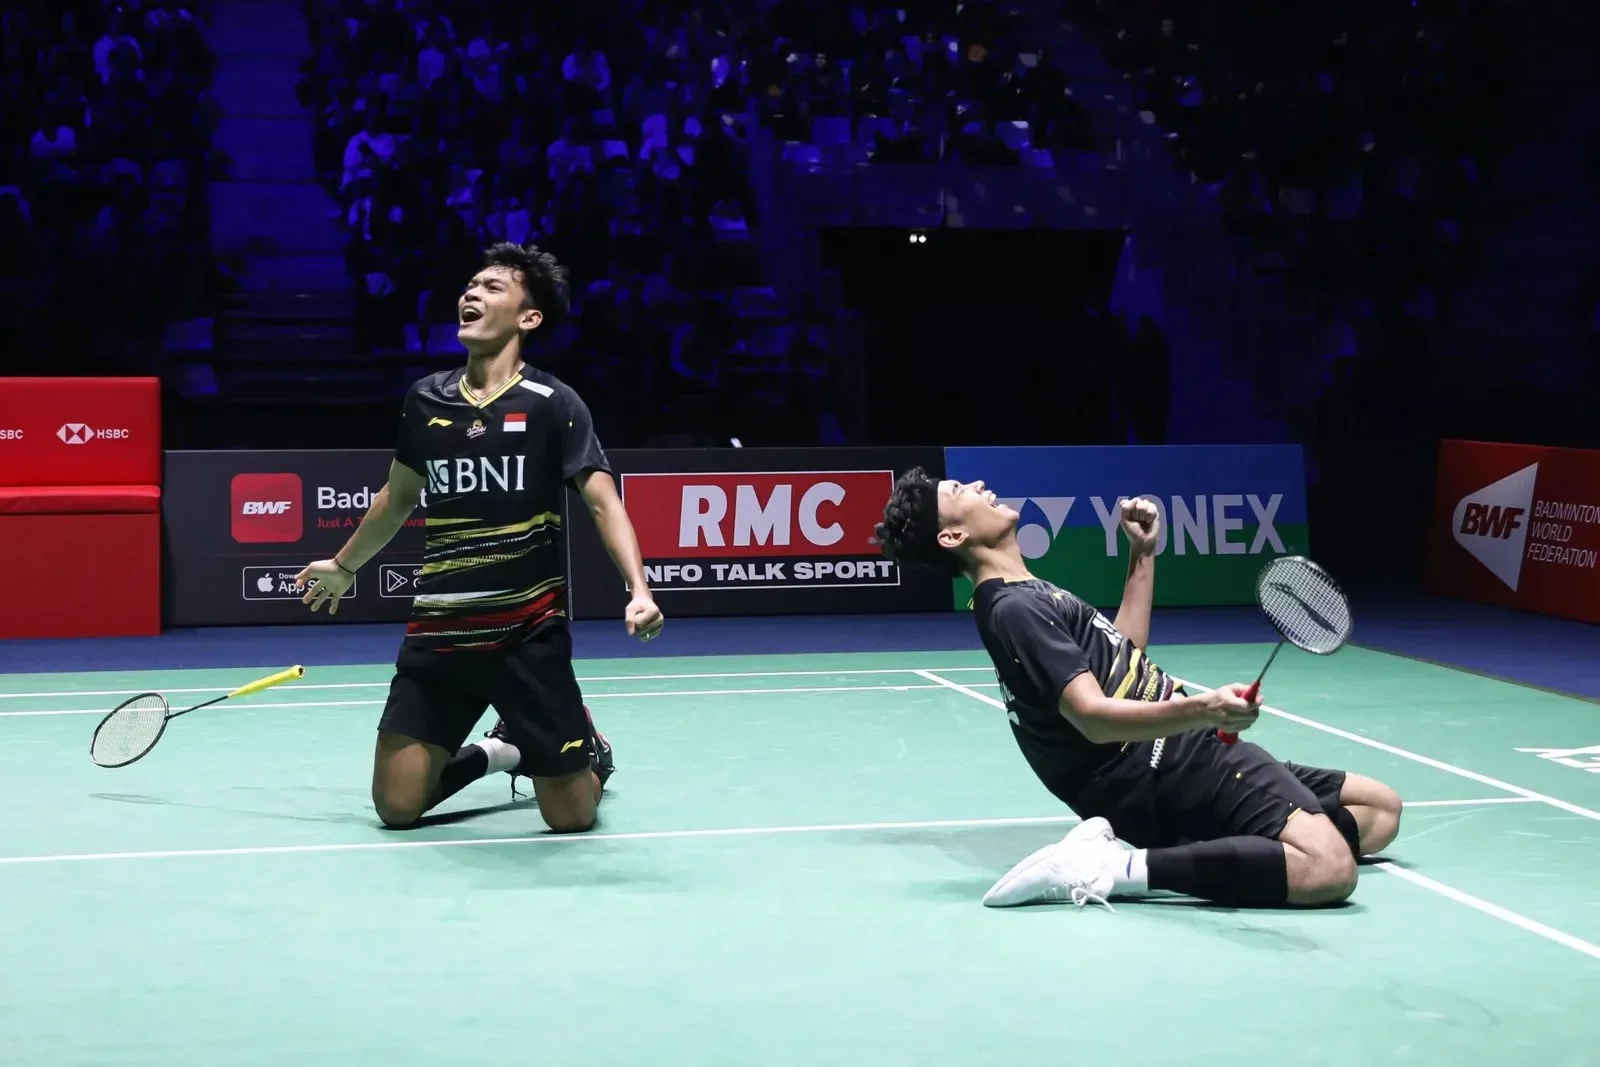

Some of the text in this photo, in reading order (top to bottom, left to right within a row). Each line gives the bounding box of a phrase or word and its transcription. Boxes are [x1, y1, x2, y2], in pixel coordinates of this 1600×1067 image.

[0, 429, 23, 439] SBC
[96, 428, 129, 439] HSBC
[455, 455, 526, 493] BNI
[242, 501, 292, 515] BWF
[678, 482, 846, 548] RMC
[1534, 500, 1600, 524] BADMINTON
[317, 516, 341, 529] Just
[343, 517, 354, 528] A
[1460, 502, 1525, 540] BWF
[1531, 521, 1573, 542] WORLD
[1527, 543, 1598, 568] FEDERATION
[643, 561, 894, 582] NFO TALK SPORT
